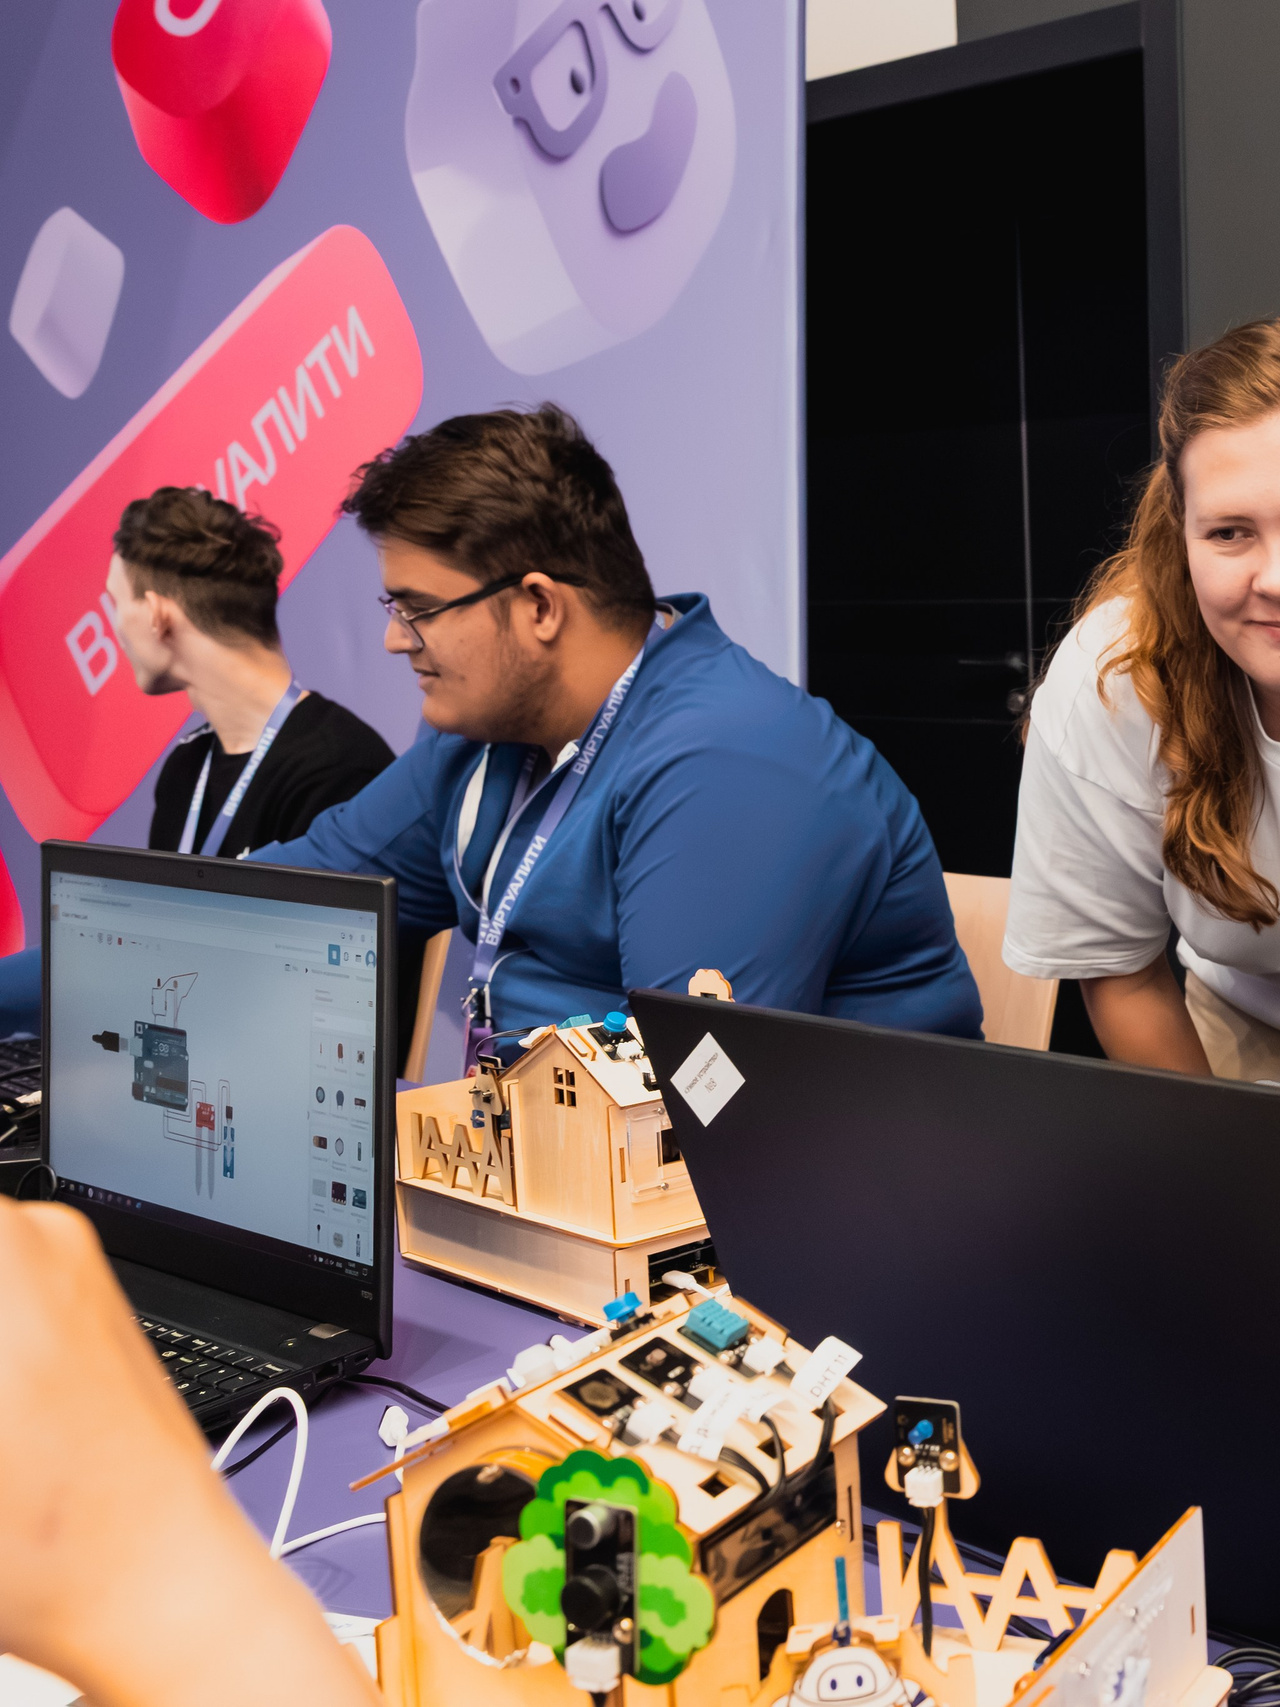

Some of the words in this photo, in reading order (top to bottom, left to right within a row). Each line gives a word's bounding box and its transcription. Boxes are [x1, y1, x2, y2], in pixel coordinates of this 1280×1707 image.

[65, 305, 375, 696] ВАЛИТИ
[573, 664, 637, 776] ВИРТУАЛИТИ
[485, 834, 547, 947] ВИРТУАЛИТИ
